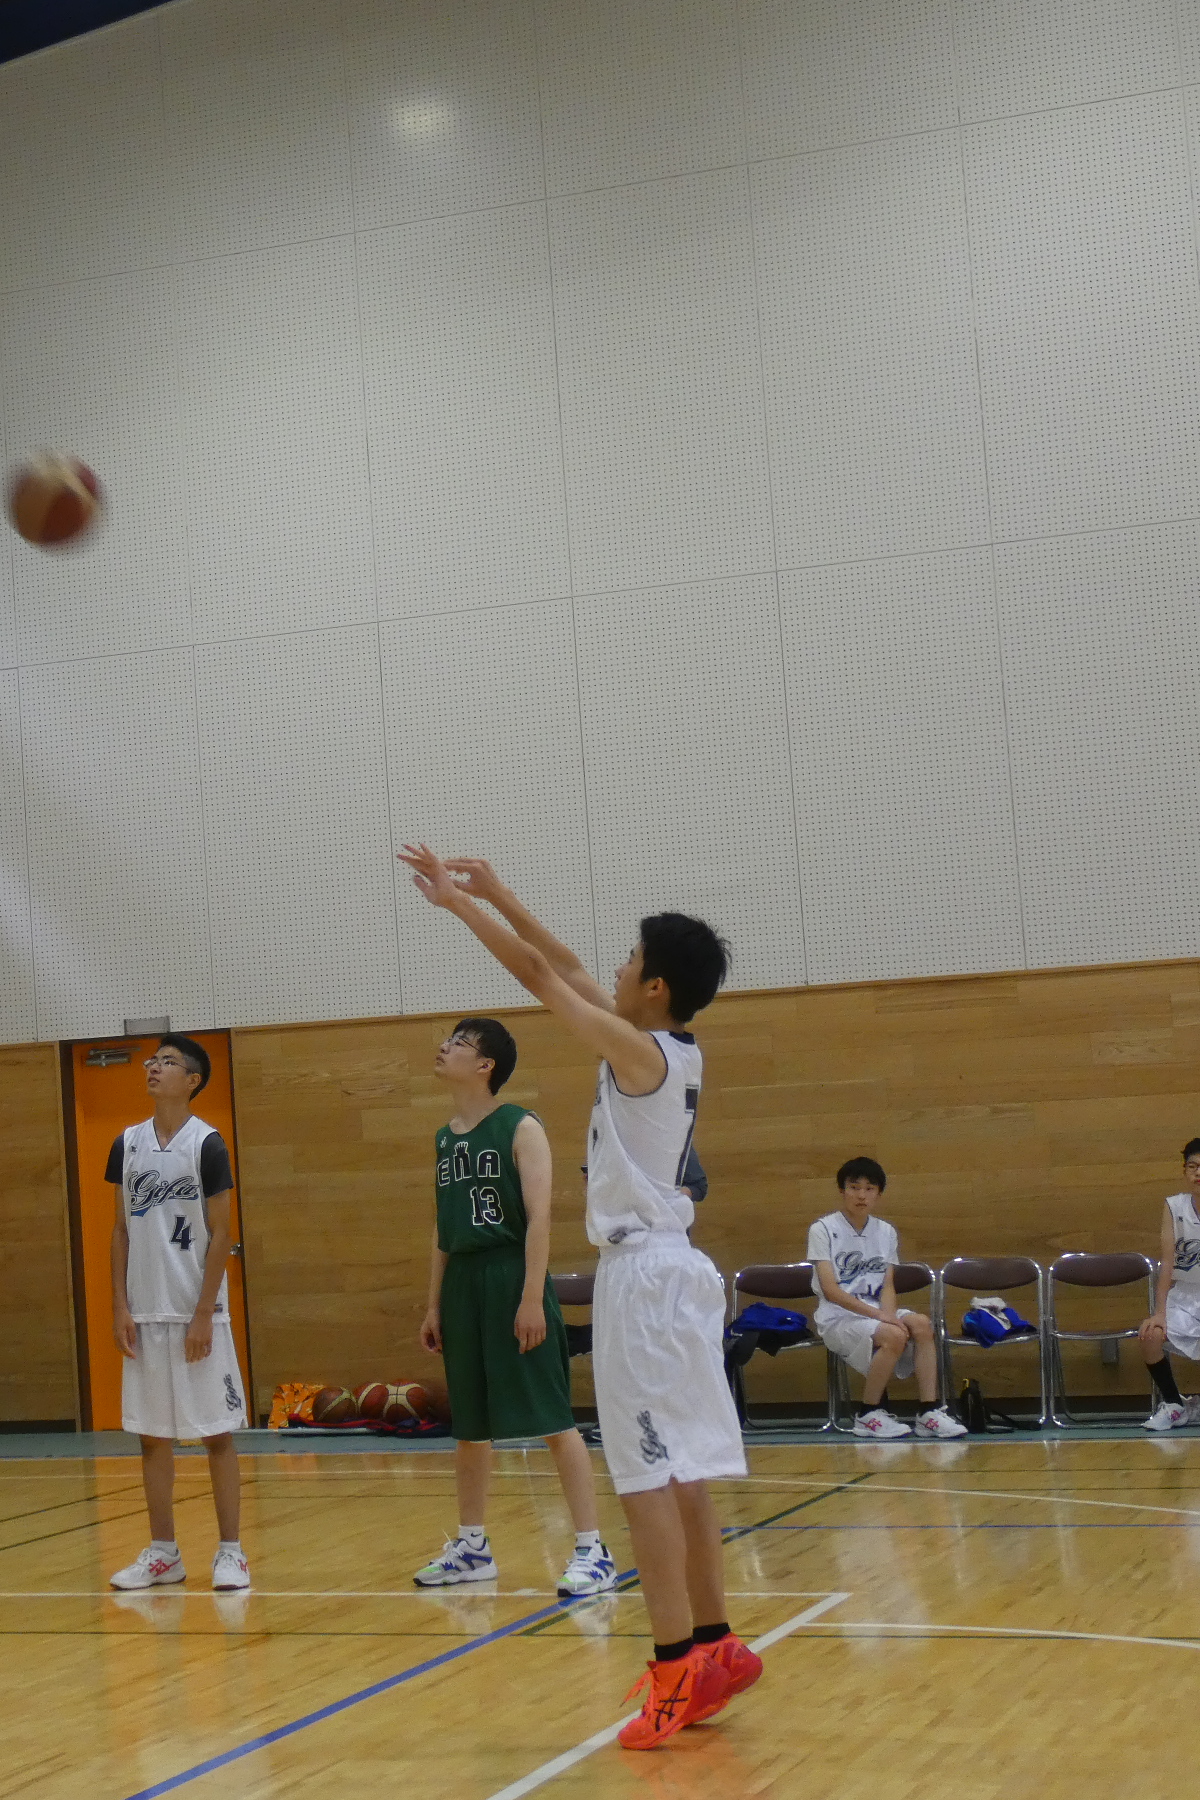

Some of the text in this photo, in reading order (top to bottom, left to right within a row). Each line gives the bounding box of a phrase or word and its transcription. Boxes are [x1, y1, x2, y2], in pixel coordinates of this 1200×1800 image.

[128, 1169, 200, 1217] Gifu
[469, 1186, 505, 1226] 13
[169, 1214, 196, 1252] 4
